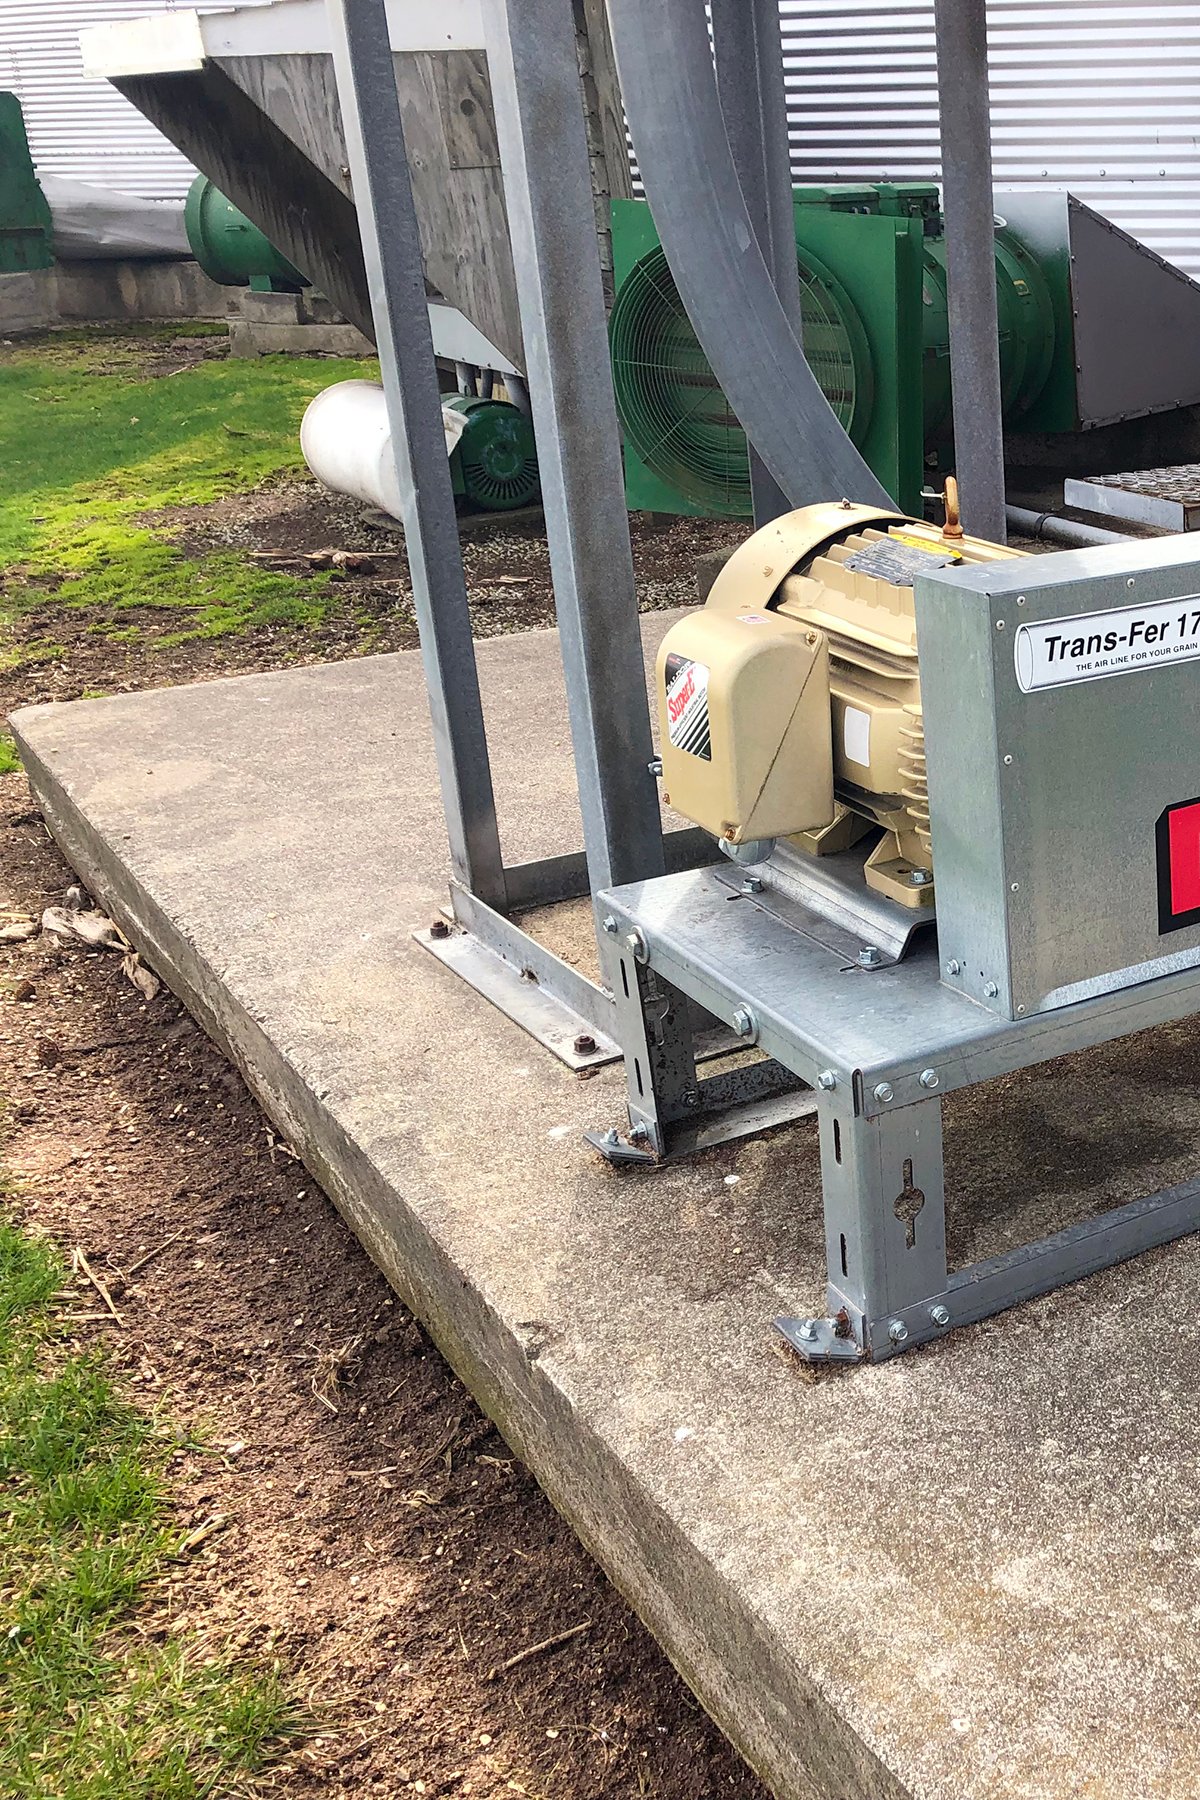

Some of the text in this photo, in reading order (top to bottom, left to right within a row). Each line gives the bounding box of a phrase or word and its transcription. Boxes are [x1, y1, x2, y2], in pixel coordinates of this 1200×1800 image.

[1044, 620, 1170, 662] Trans-Fer
[1076, 642, 1199, 672] THE AIR LINE FOR YOUR GRAIN
